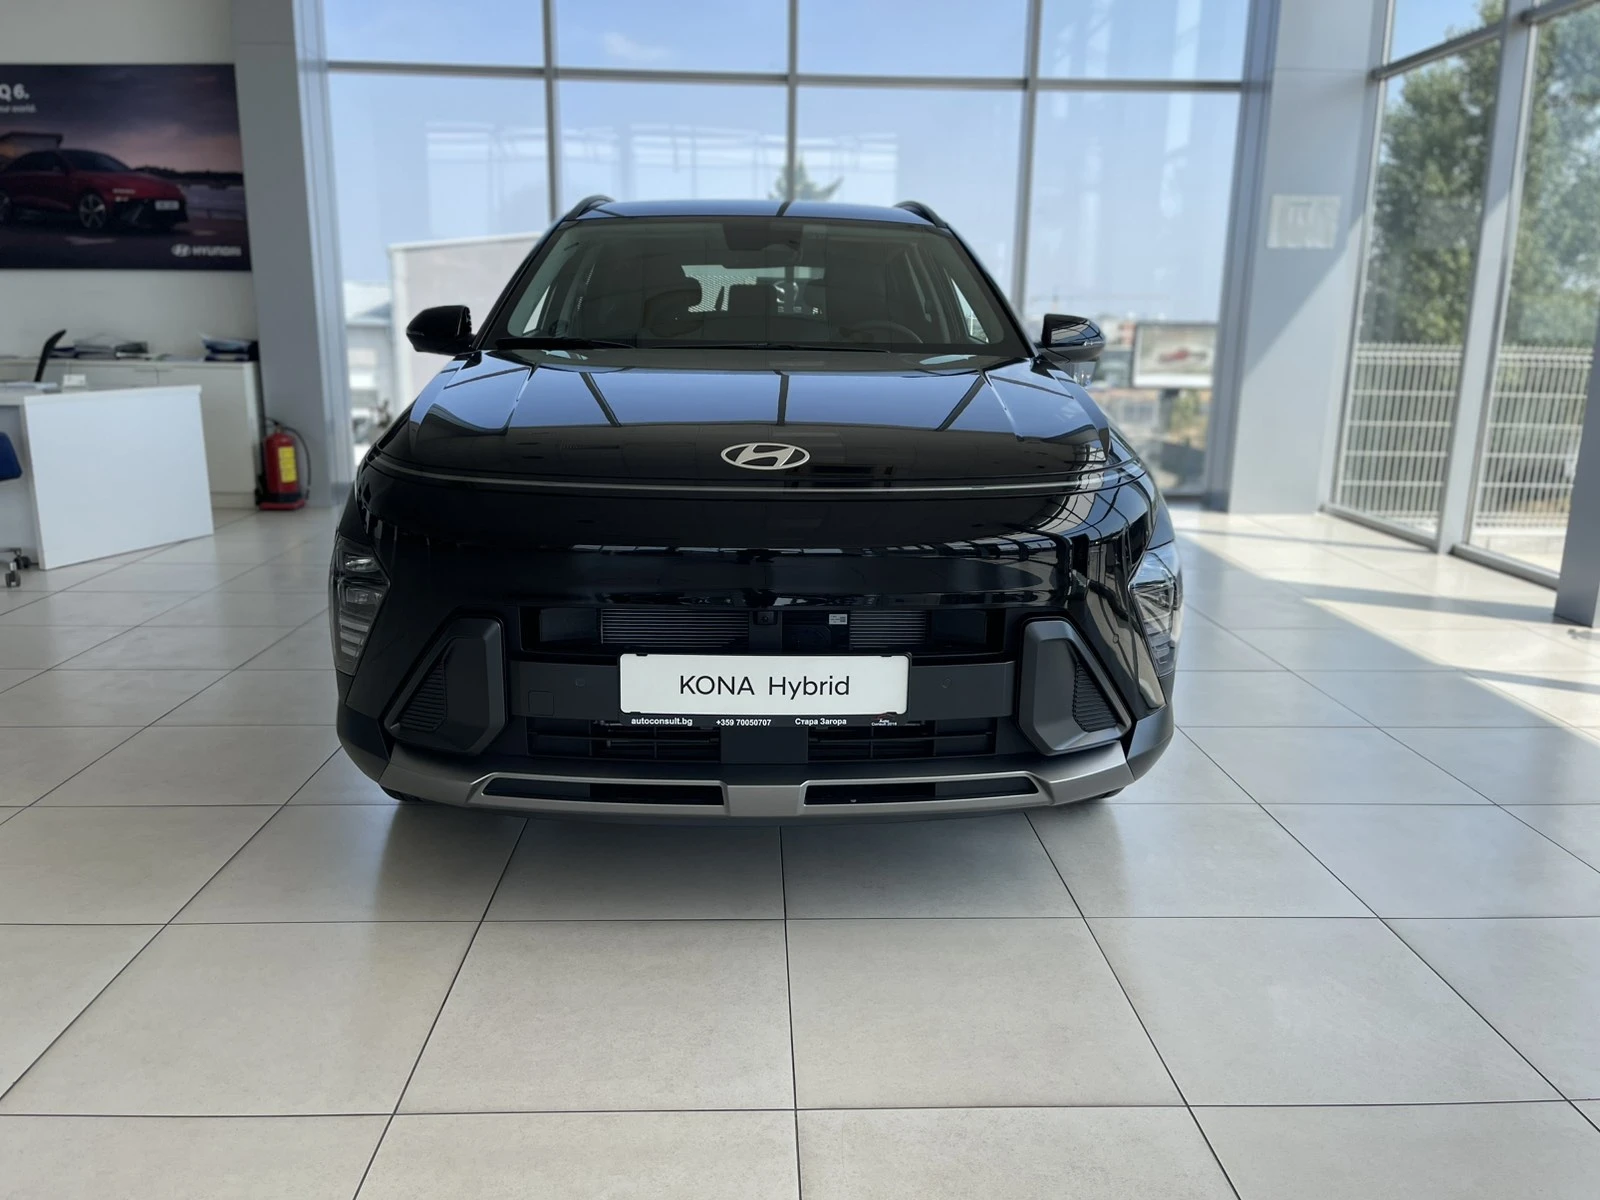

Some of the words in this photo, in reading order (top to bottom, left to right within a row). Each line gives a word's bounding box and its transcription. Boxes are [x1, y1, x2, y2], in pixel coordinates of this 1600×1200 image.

[13, 83, 30, 100] 6.
[680, 675, 755, 696] KONA
[769, 675, 850, 700] Hybrid
[631, 717, 693, 726] autoconsult.bg
[716, 718, 735, 726] +359
[736, 718, 772, 726] 70050707
[795, 717, 818, 726] Стара
[819, 717, 847, 726] Загора
